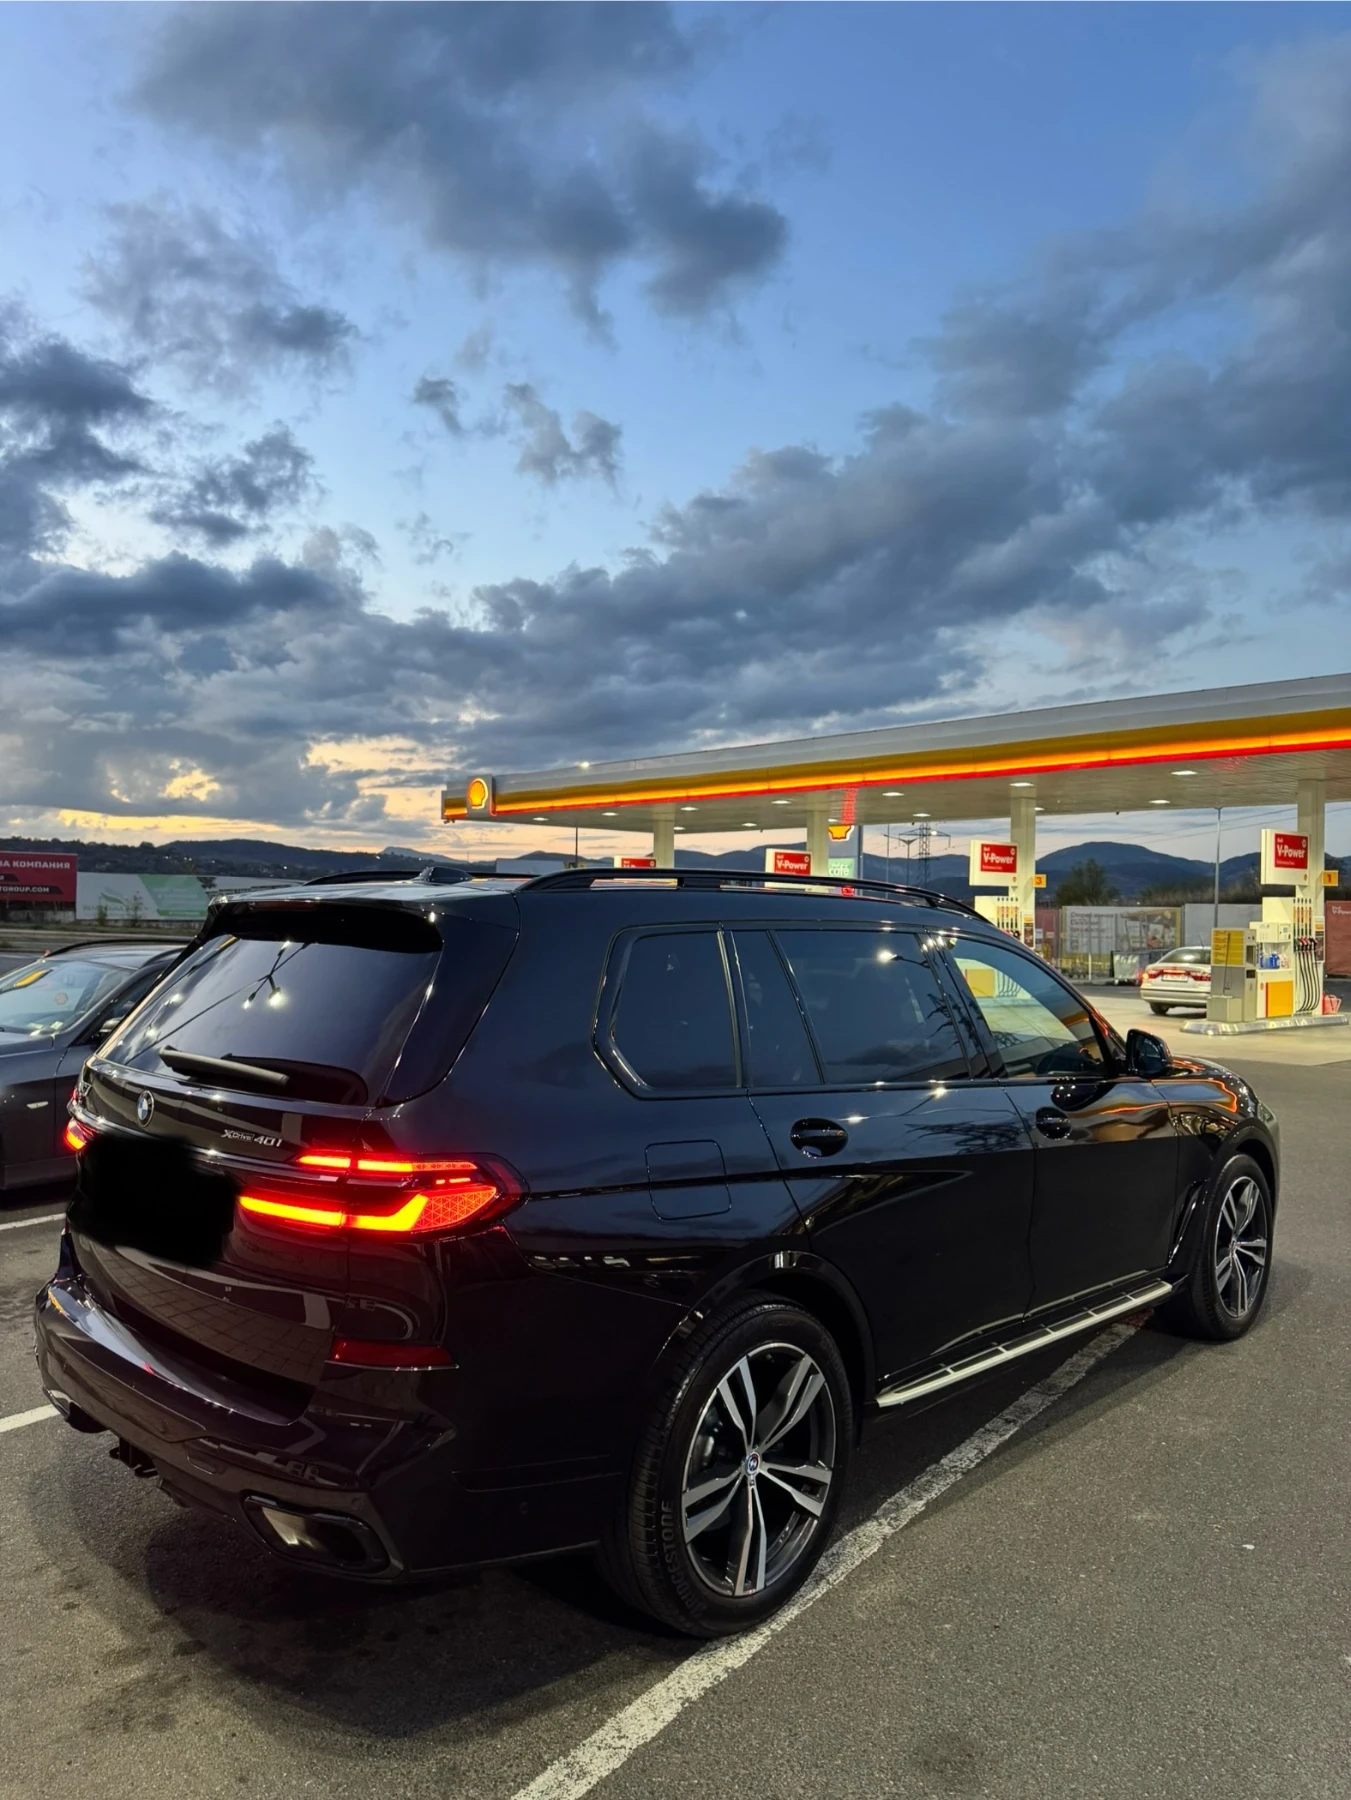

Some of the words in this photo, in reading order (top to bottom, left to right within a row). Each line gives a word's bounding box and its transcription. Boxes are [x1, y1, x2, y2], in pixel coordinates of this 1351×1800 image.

[1276, 844, 1306, 859] V-Power
[983, 852, 1014, 864] V-Power
[12, 860, 71, 870] КОМПАНИЯ
[776, 859, 808, 871] V-Power
[1035, 876, 1043, 885] 3
[660, 1499, 707, 1618] BRIDGESTONE
